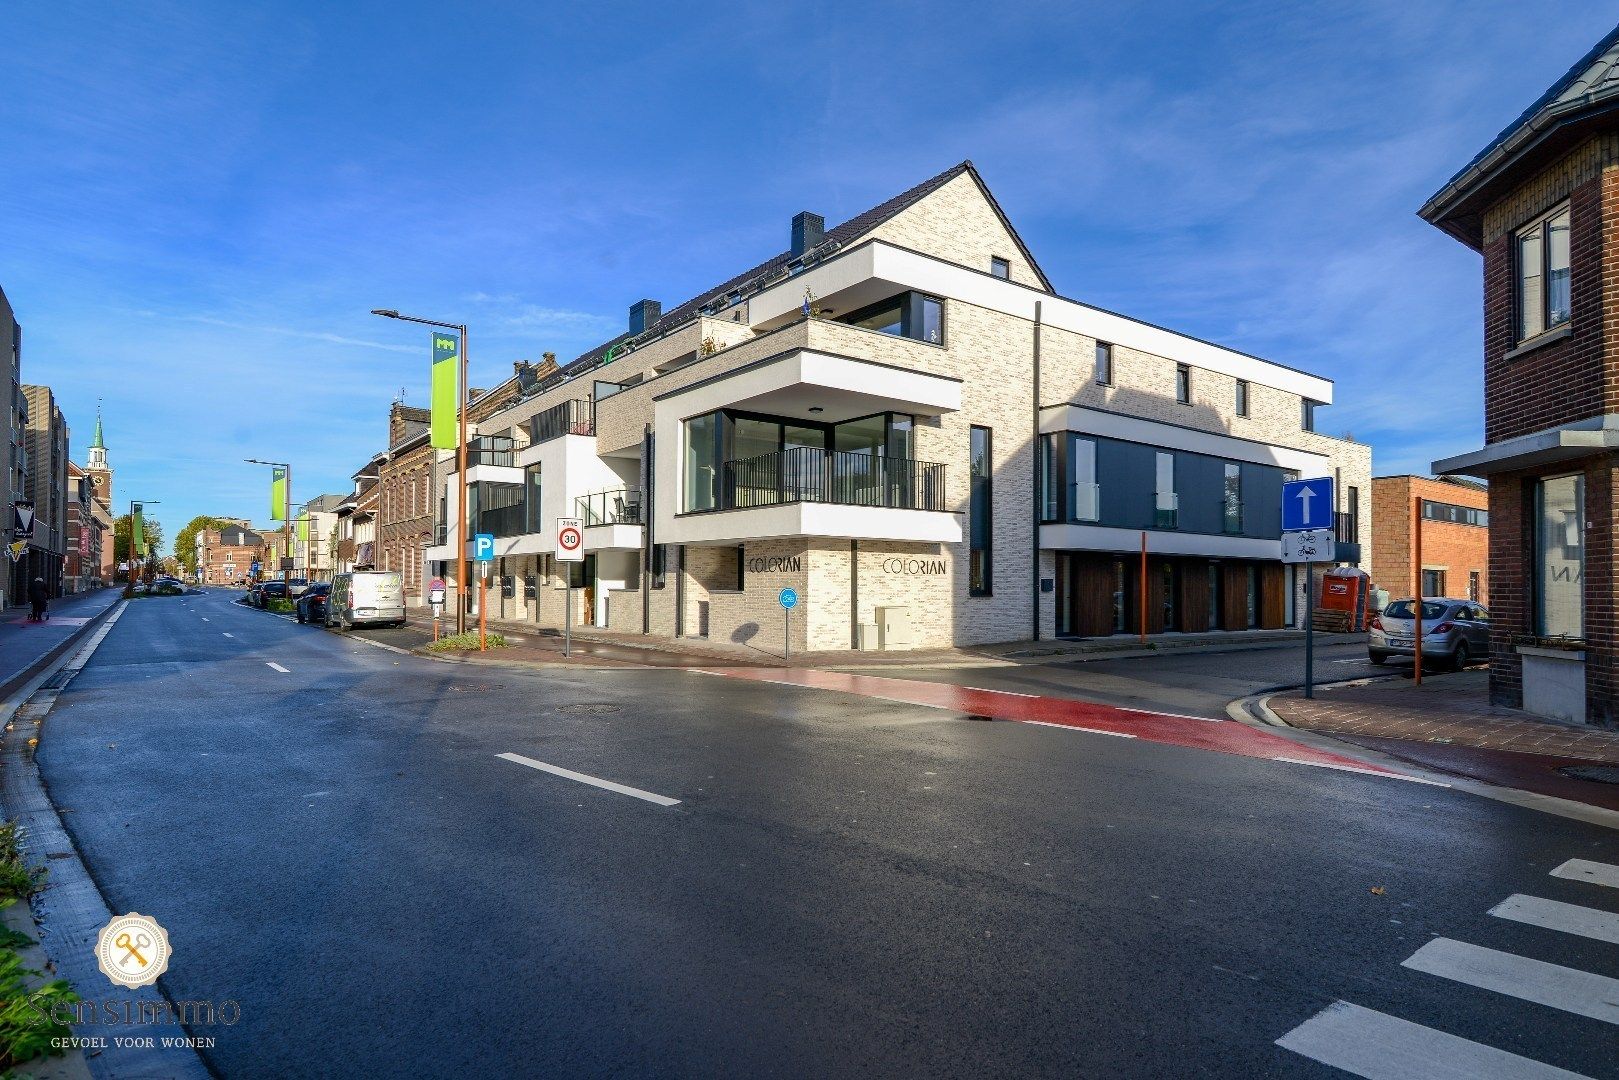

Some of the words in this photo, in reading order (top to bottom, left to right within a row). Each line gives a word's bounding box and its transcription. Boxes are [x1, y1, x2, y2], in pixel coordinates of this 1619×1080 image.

[478, 538, 491, 557] P
[564, 535, 576, 544] 30
[749, 556, 801, 573] COLORIAN
[882, 558, 946, 575] COLORIAN
